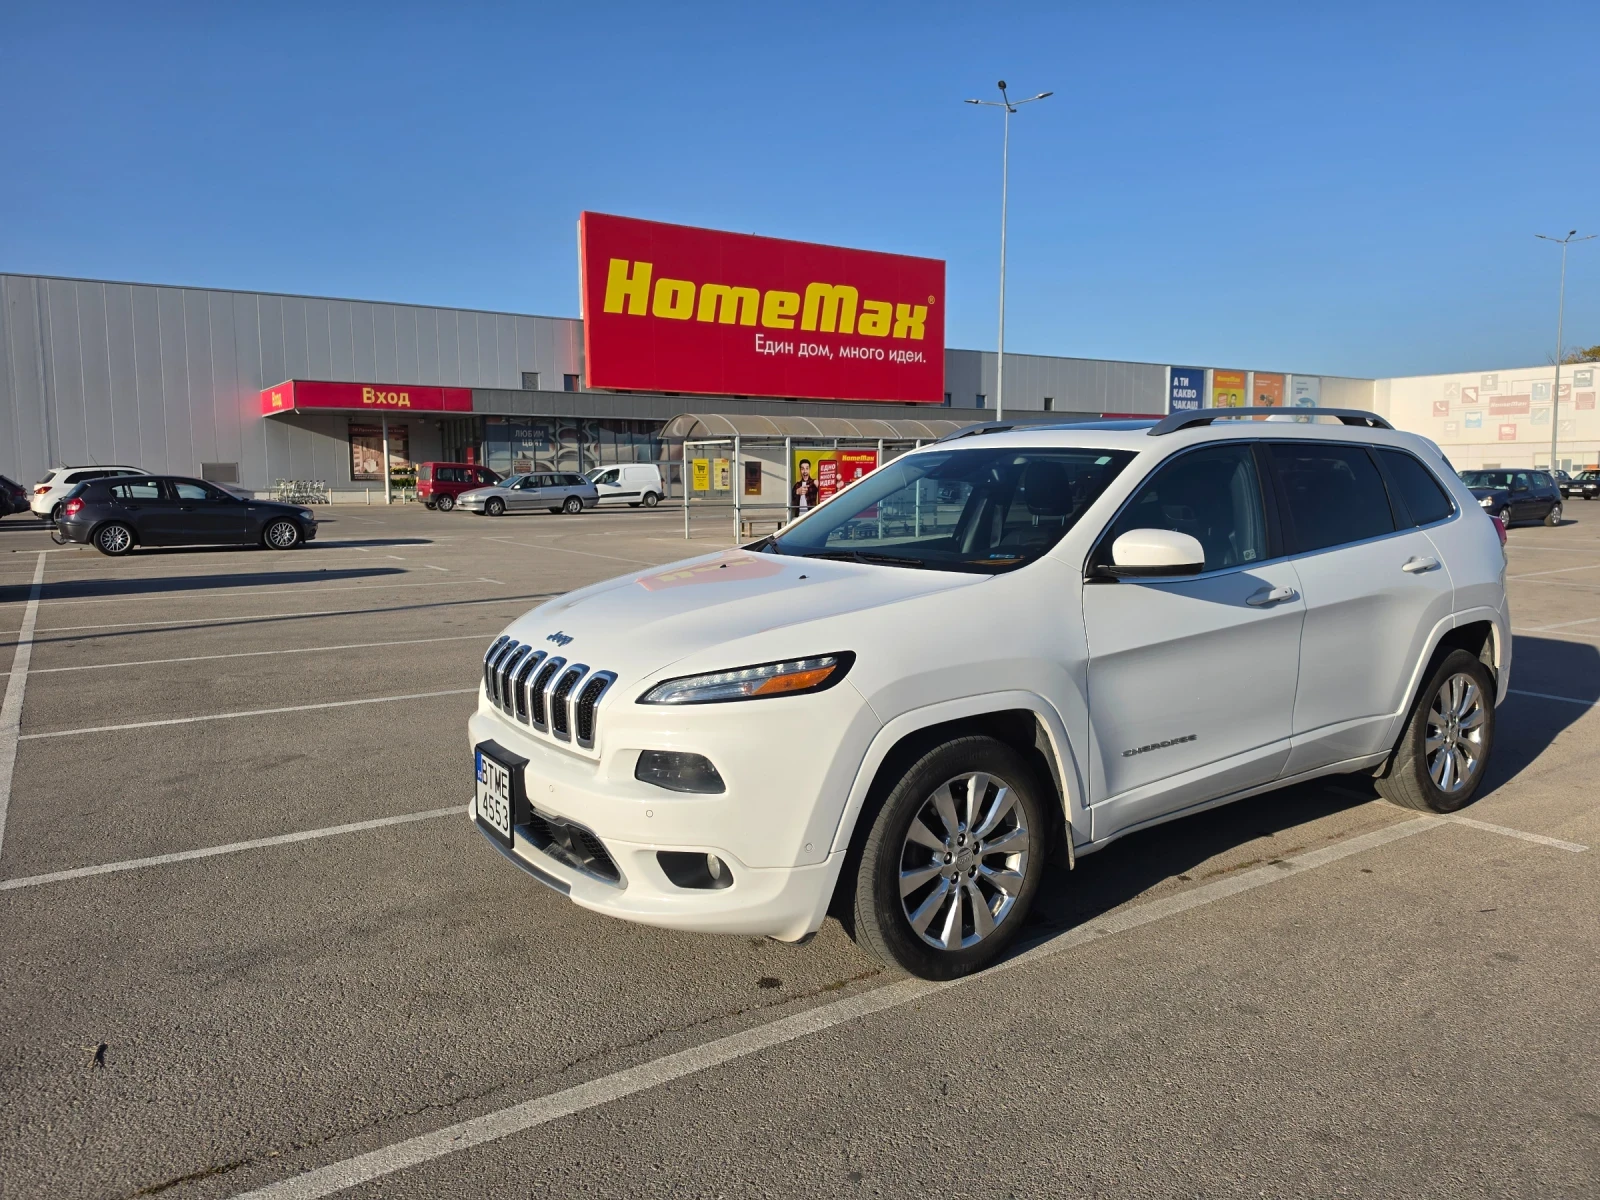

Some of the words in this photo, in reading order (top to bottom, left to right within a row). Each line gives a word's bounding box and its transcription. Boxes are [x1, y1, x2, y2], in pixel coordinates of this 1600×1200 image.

[603, 258, 928, 340] HomeMax
[755, 333, 794, 355] Един
[798, 343, 834, 360] дом,
[839, 345, 885, 361] много
[888, 350, 927, 363] идеи.
[1173, 377, 1179, 386] А
[1180, 377, 1189, 386] ТИ
[362, 387, 411, 407] Вход
[1173, 389, 1197, 398] КАКВО
[515, 429, 545, 438] ЛЮБИМ
[820, 464, 836, 472] ЕДНО
[1121, 734, 1197, 757] CHEROKEE
[482, 758, 508, 801] BTME
[483, 791, 509, 832] 4553
